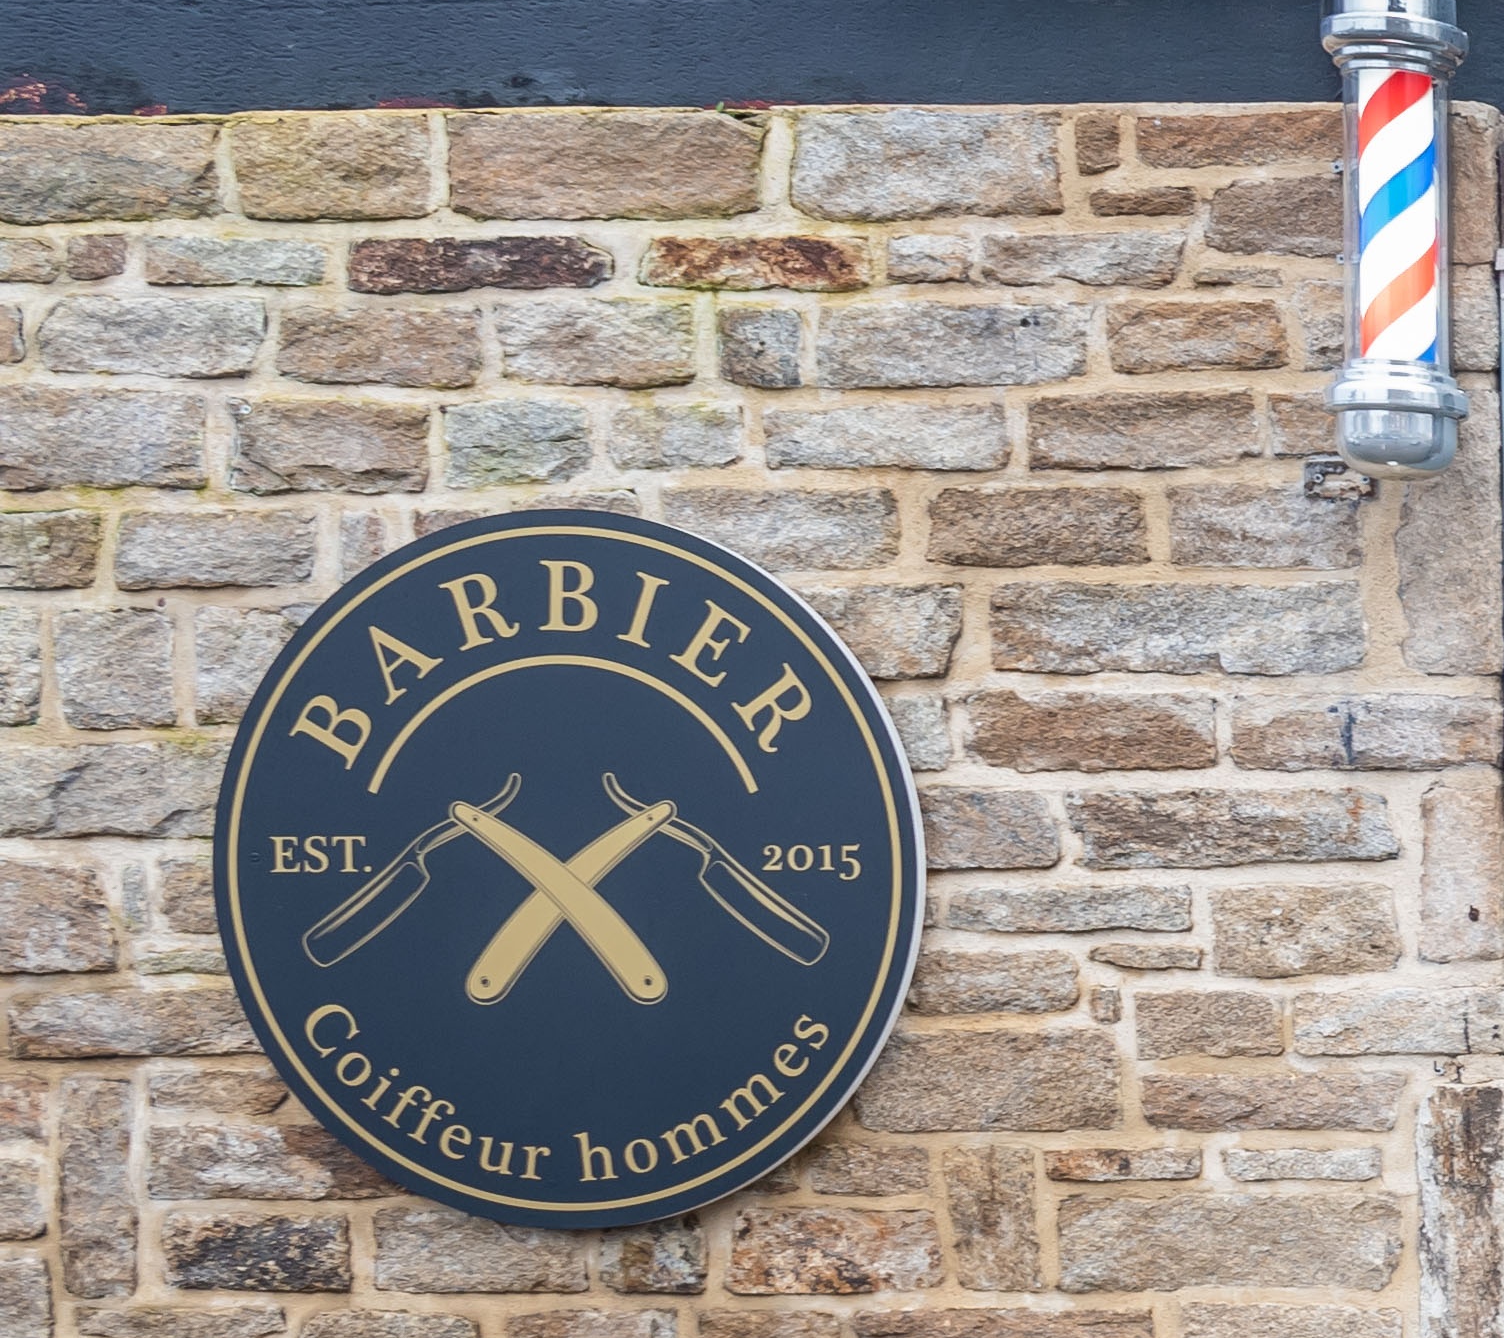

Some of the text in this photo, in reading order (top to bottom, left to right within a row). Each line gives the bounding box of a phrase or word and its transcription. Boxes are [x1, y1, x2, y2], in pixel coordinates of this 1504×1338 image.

[289, 559, 813, 771] BARBIER
[269, 835, 862, 882] EST. 2015
[303, 1003, 830, 1183] Coiffeur hommes
